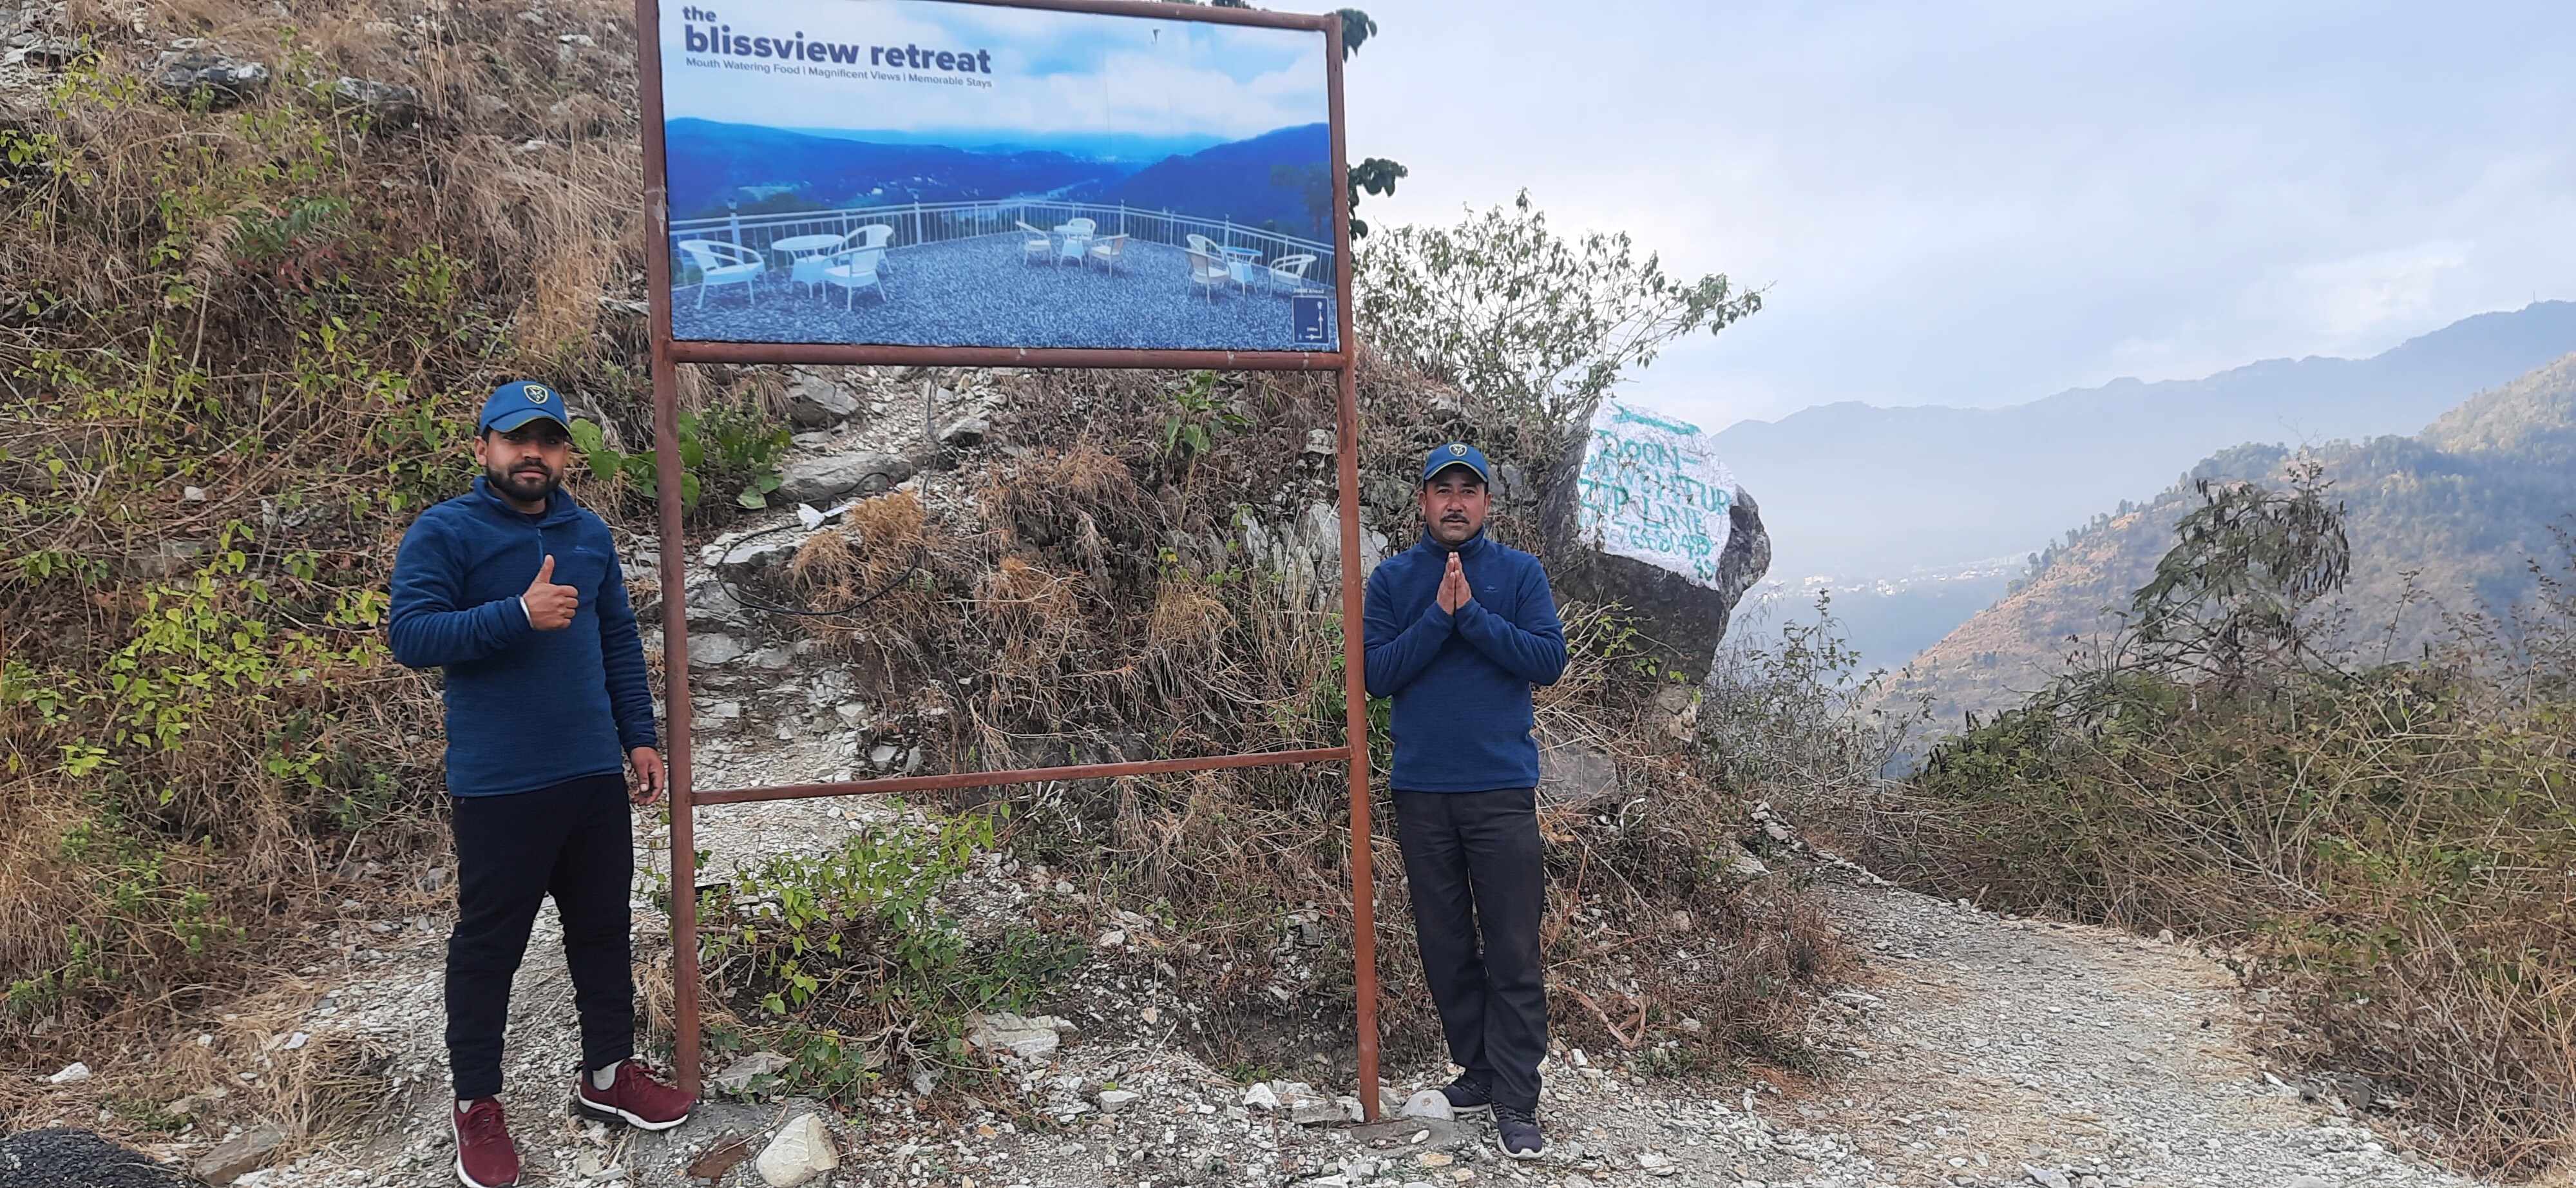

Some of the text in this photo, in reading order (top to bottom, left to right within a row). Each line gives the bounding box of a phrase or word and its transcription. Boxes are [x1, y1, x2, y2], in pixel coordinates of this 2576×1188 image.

[682, 5, 716, 22] the
[685, 24, 991, 74] blissview retreat
[686, 57, 720, 68] Mouth
[723, 59, 770, 73] Watering
[774, 64, 800, 75] Food
[808, 67, 868, 79] Magnificent
[870, 70, 901, 81] Views
[908, 73, 964, 86] Memorable
[966, 77, 993, 90] Stays
[1642, 493, 1710, 537] LINE
